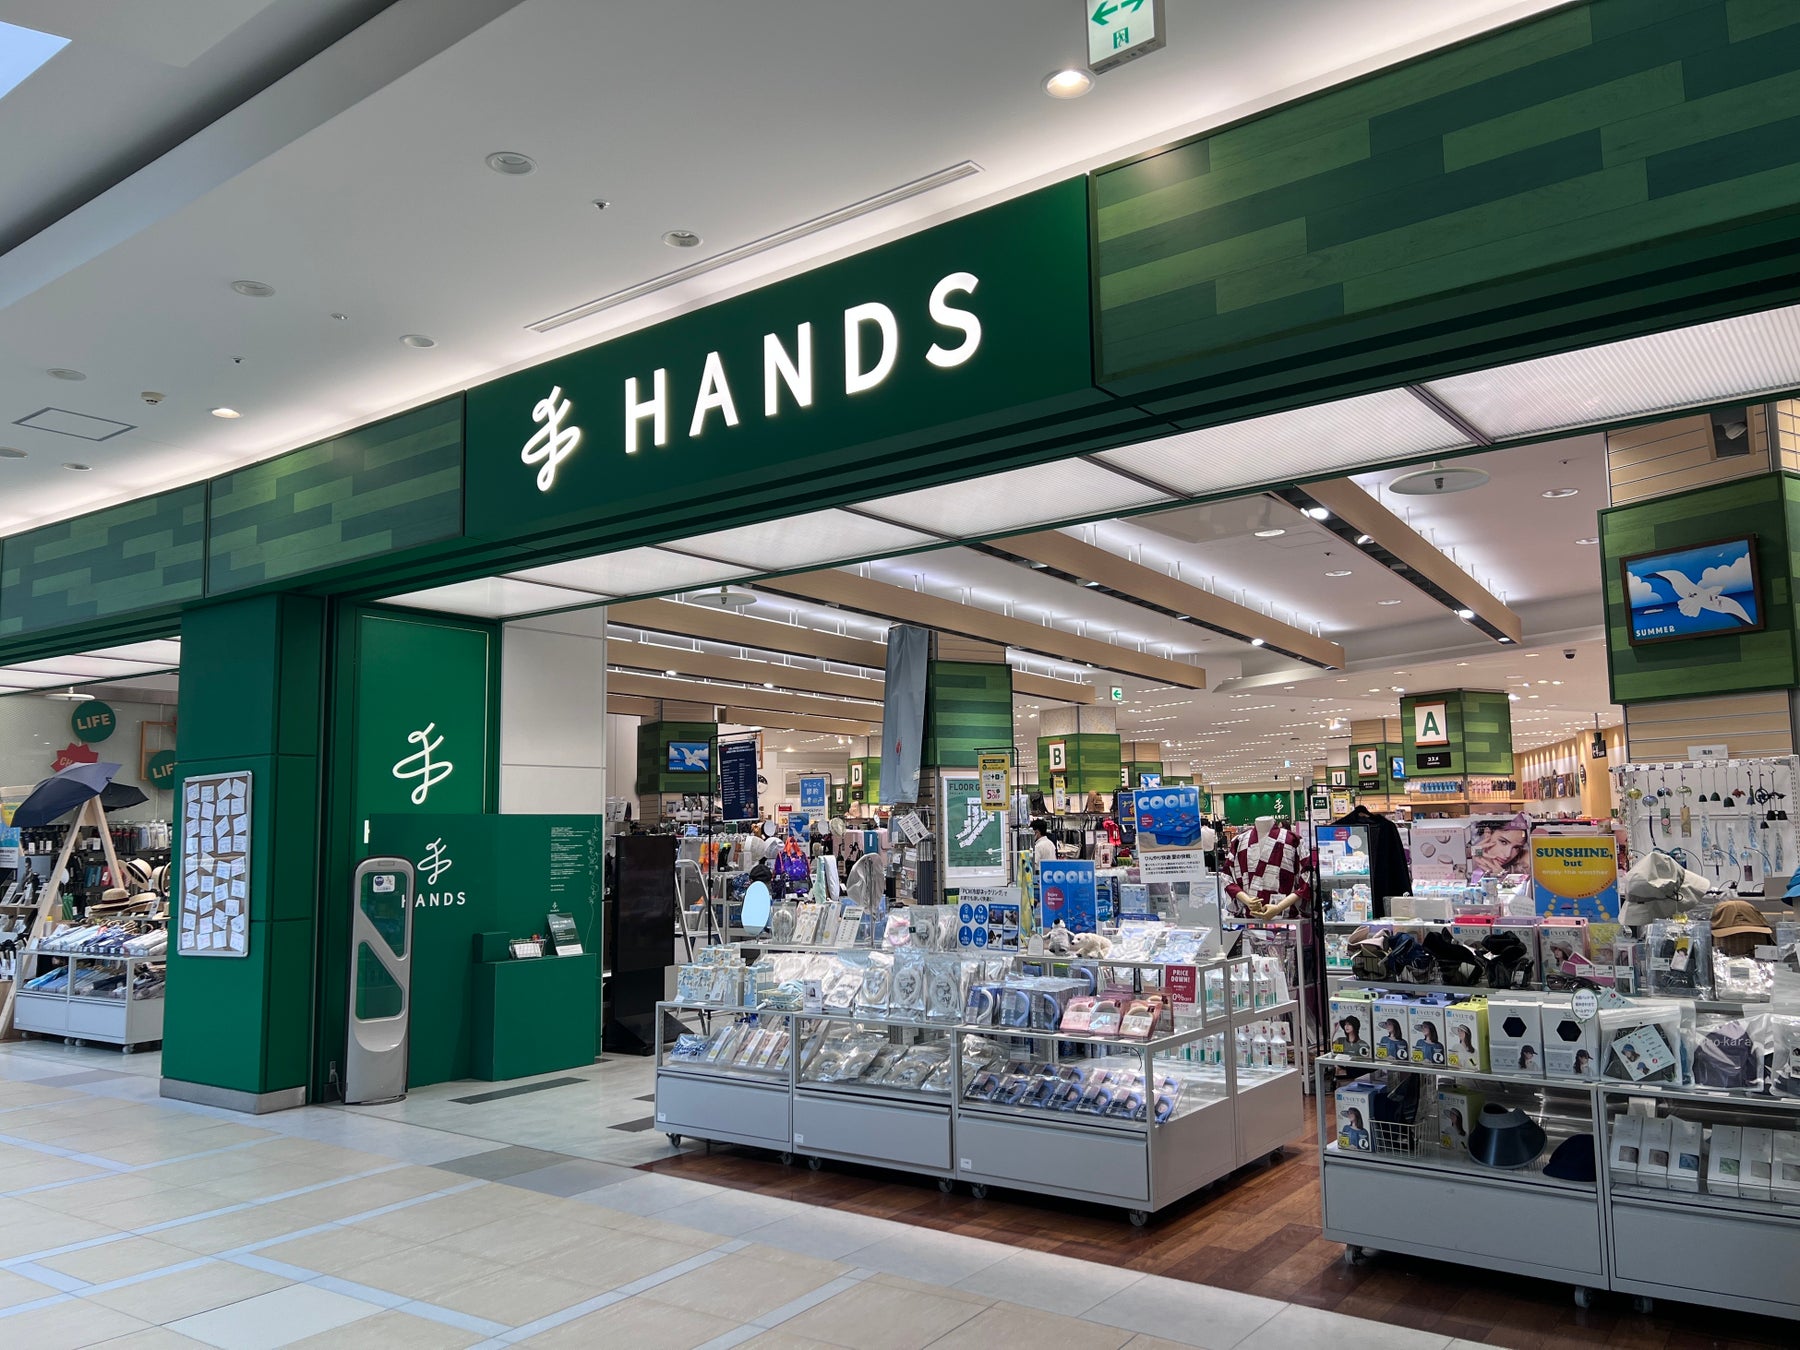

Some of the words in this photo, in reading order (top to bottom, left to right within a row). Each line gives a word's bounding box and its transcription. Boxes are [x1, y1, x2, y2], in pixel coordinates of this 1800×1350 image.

[624, 271, 982, 454] HANDS
[1635, 625, 1676, 638] SUMMER
[77, 714, 112, 730] LIFE
[1421, 711, 1440, 737] A
[1053, 748, 1062, 766] B
[1363, 754, 1372, 770] C
[152, 761, 178, 779] LIF
[854, 768, 860, 782] D
[1335, 773, 1342, 785] U
[1138, 793, 1196, 810] COOL!
[1535, 847, 1614, 860] SUNSHINE,
[1042, 870, 1093, 884] COOL!
